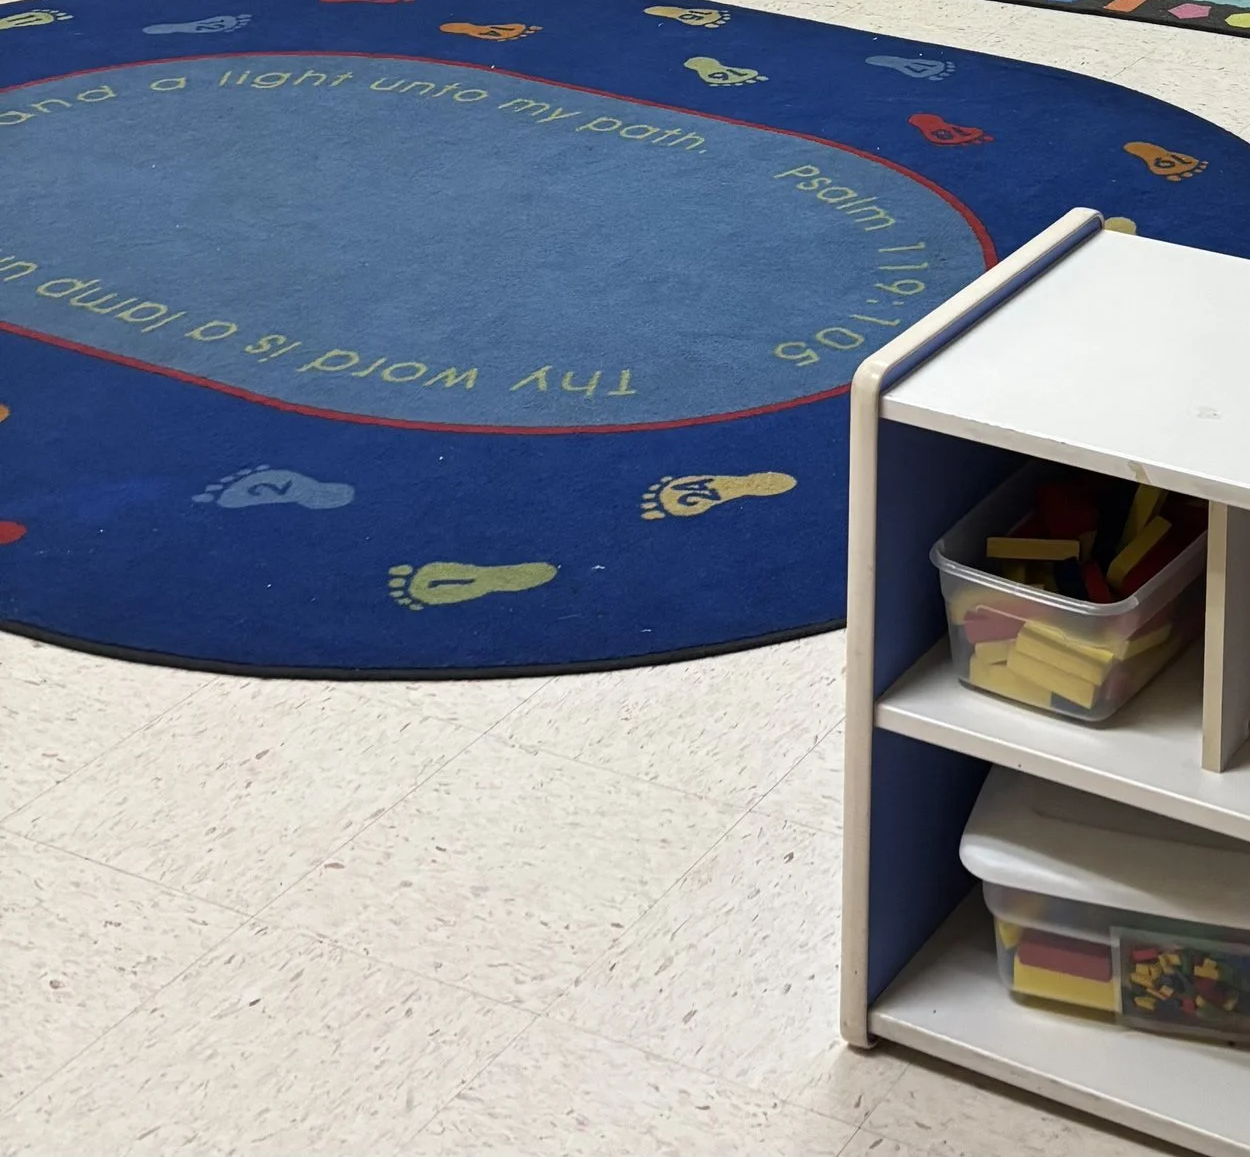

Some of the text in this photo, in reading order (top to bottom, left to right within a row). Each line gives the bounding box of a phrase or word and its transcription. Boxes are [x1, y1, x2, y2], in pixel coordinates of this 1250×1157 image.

[708, 69, 748, 81] 16
[0, 85, 117, 126] and
[149, 77, 188, 91] a
[218, 69, 353, 89] light
[369, 77, 489, 102] unto
[497, 98, 582, 124] my
[773, 164, 928, 367] Psalm 119:105
[36, 278, 187, 333] lamp
[184, 320, 238, 342] a
[245, 334, 302, 364] is
[296, 348, 478, 391] word
[509, 365, 638, 398] Thy
[247, 479, 293, 499] 2
[669, 477, 721, 507] 24
